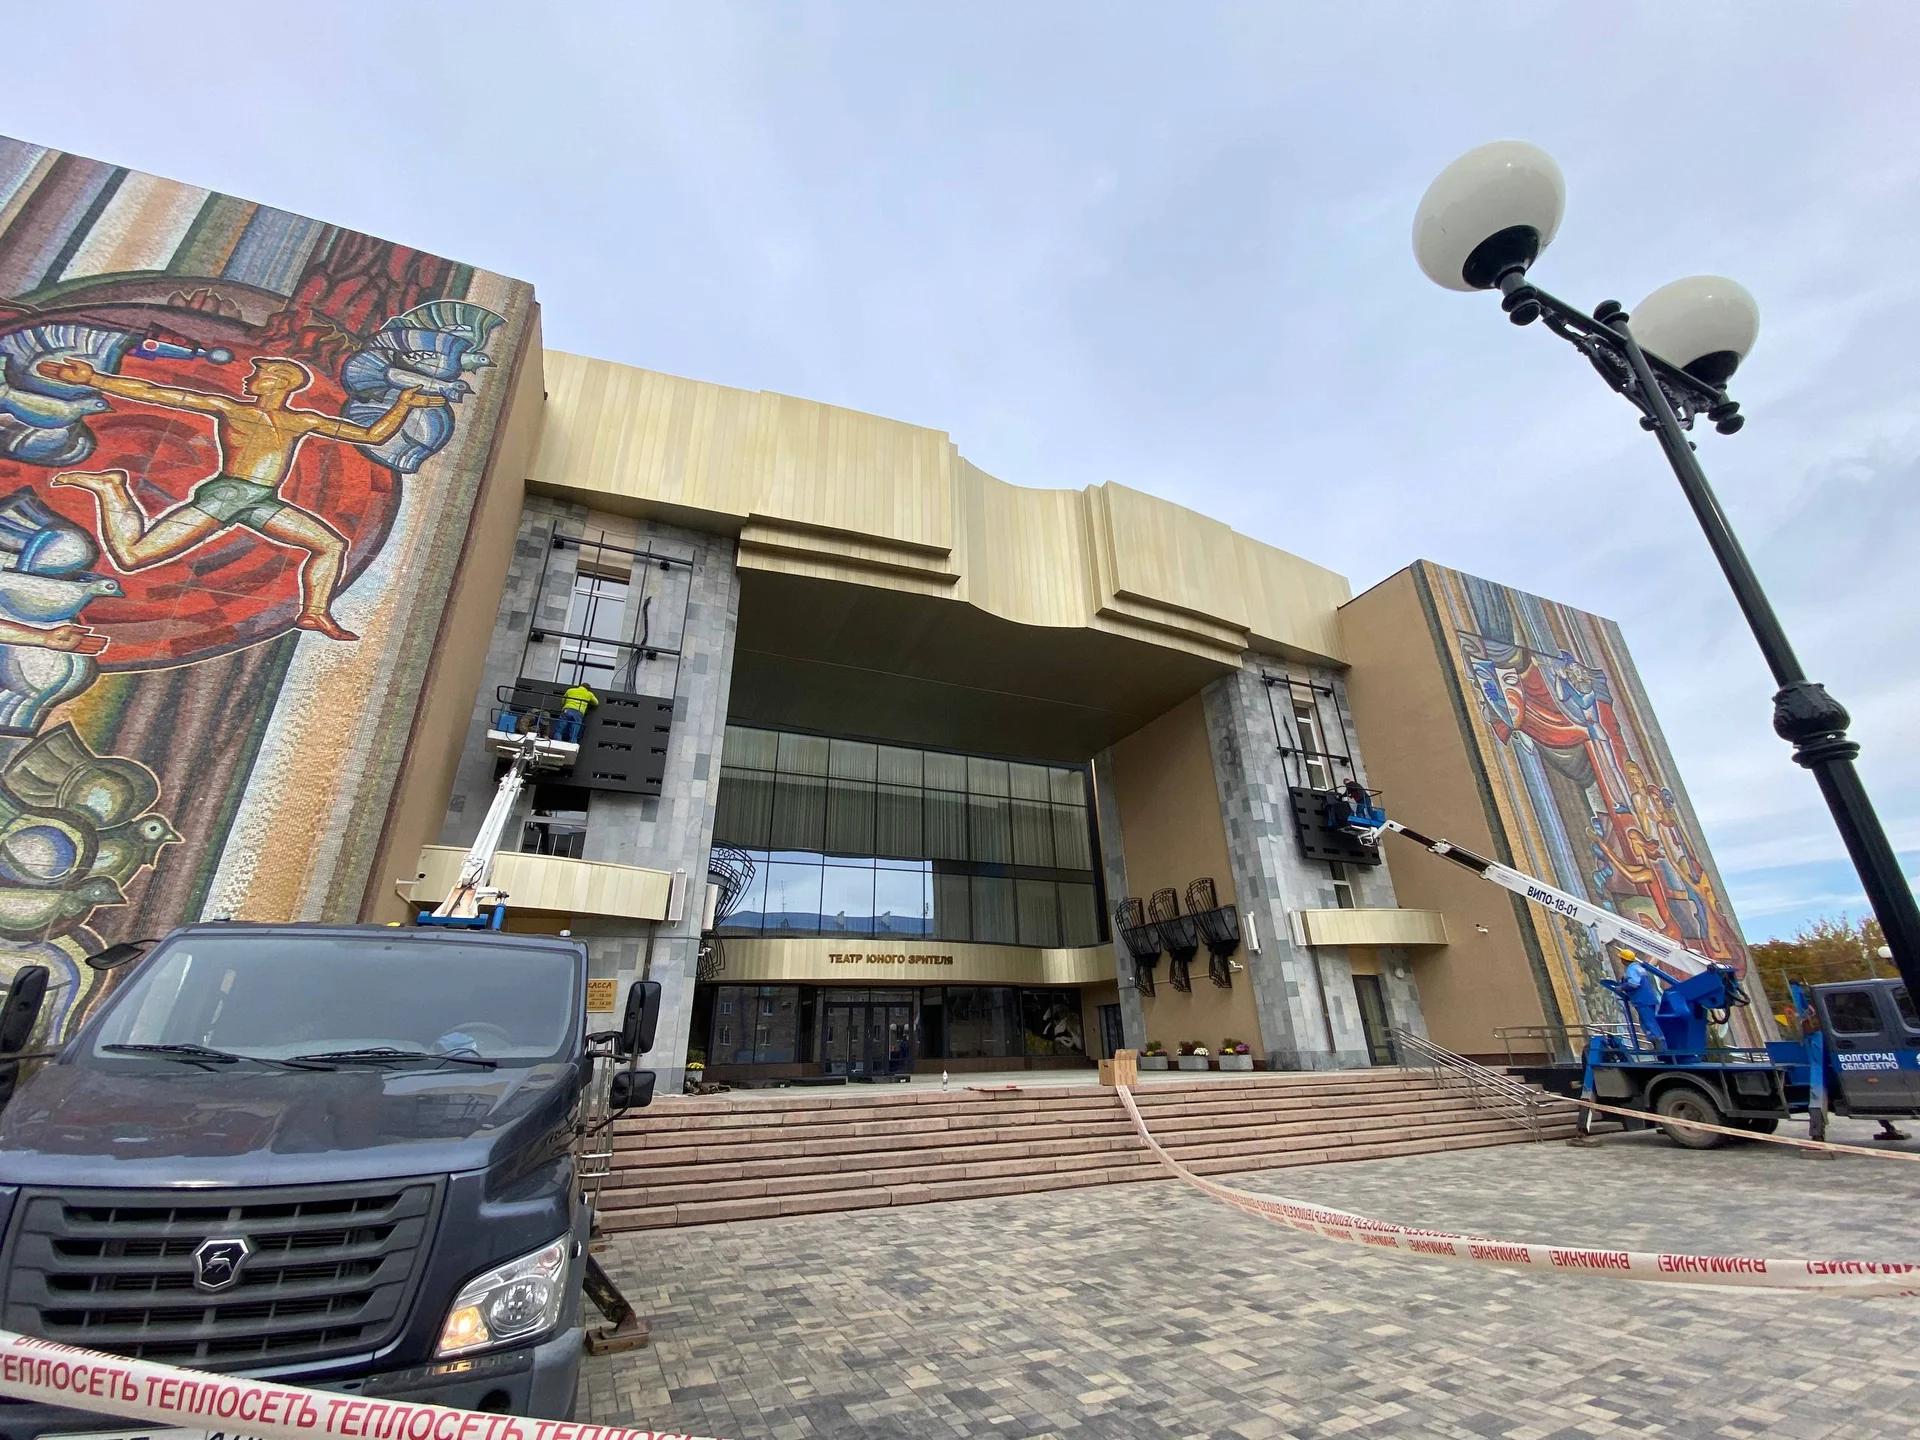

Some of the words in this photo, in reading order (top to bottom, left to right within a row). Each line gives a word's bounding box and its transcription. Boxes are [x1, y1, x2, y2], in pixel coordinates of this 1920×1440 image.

[1527, 886, 1578, 917] ВИПО-18-01
[828, 954, 863, 964] ТЕАТР
[866, 954, 905, 964] ЮНОГО
[908, 955, 953, 965] ЗРИТЕЛЯ
[1838, 1052, 1896, 1063] ВОЛГОГРАД
[1841, 1061, 1899, 1071] ОБЛЭЛЕКТРО
[1407, 1239, 1456, 1256] ВНИМАНИЕ!
[1467, 1244, 1531, 1264] ВНИМАНИЕ!
[1548, 1250, 1631, 1270] ВНИМАНИЕ!
[1657, 1254, 1767, 1274] ВНИМАНИЕ!
[0, 1352, 140, 1402] ЕПЛОСЕТЬ
[146, 1375, 319, 1429] ТЕПЛОСЕТЬ
[326, 1399, 524, 1440] ТЕПЛОСЕТЬ
